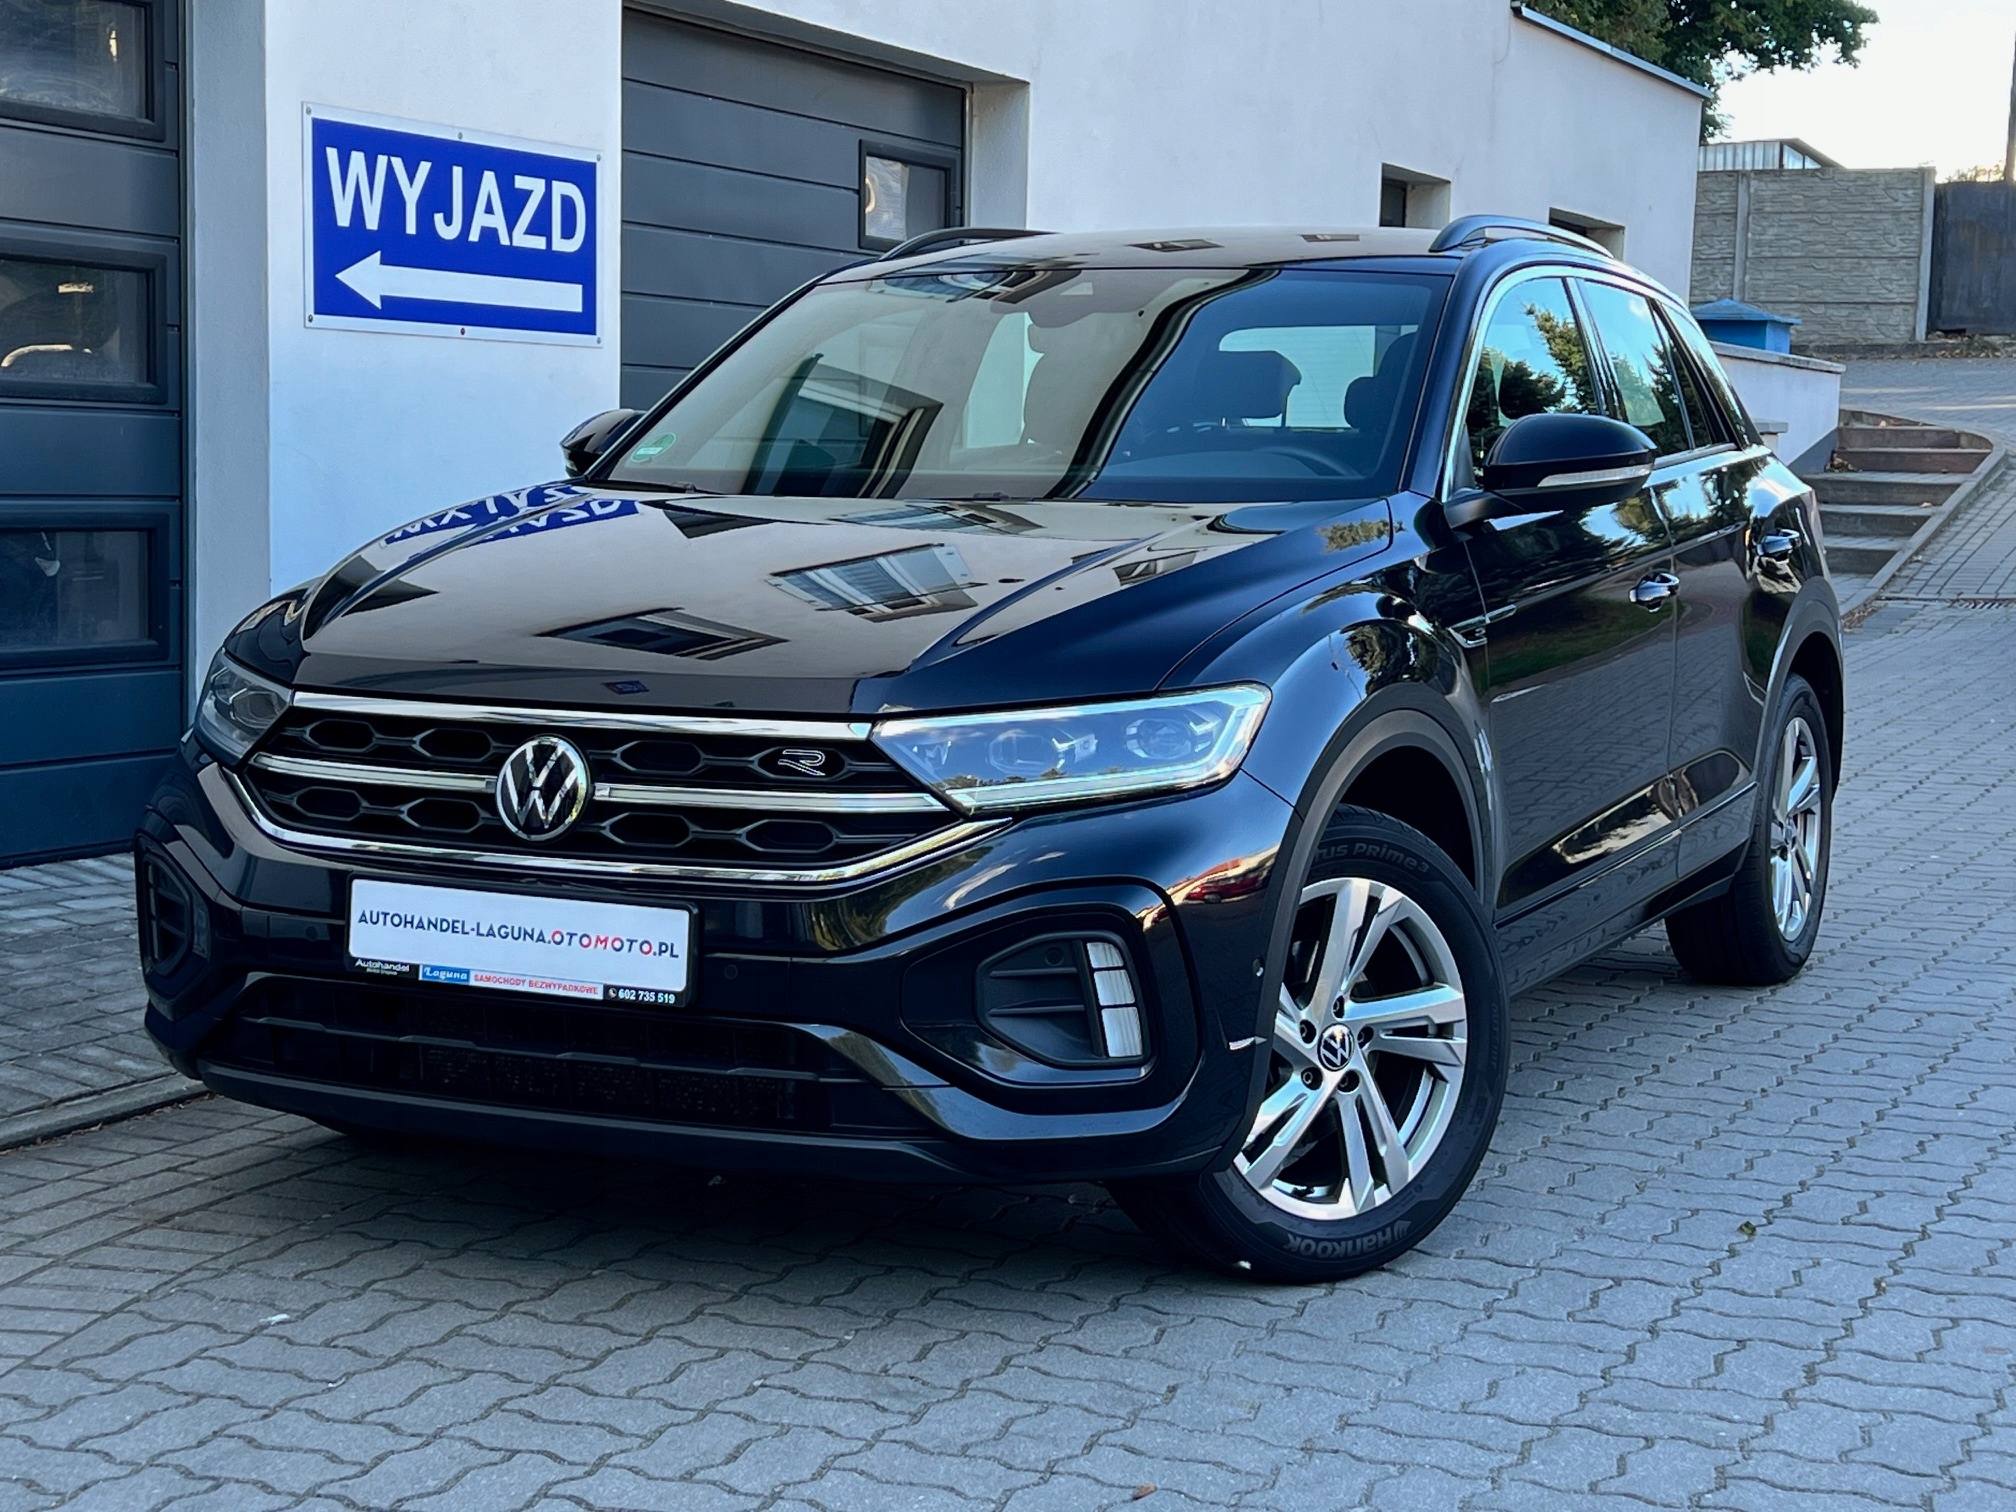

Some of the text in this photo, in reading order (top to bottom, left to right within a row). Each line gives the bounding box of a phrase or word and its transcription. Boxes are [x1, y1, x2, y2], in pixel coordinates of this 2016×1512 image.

[325, 146, 587, 253] WYJAZD
[357, 909, 680, 959] AUTOHANDEL-LAGUNA.OTOMOTO.PL
[423, 966, 468, 980] Laguna
[474, 973, 527, 987] SAMOCHODY
[618, 988, 676, 1005] 602 735 519
